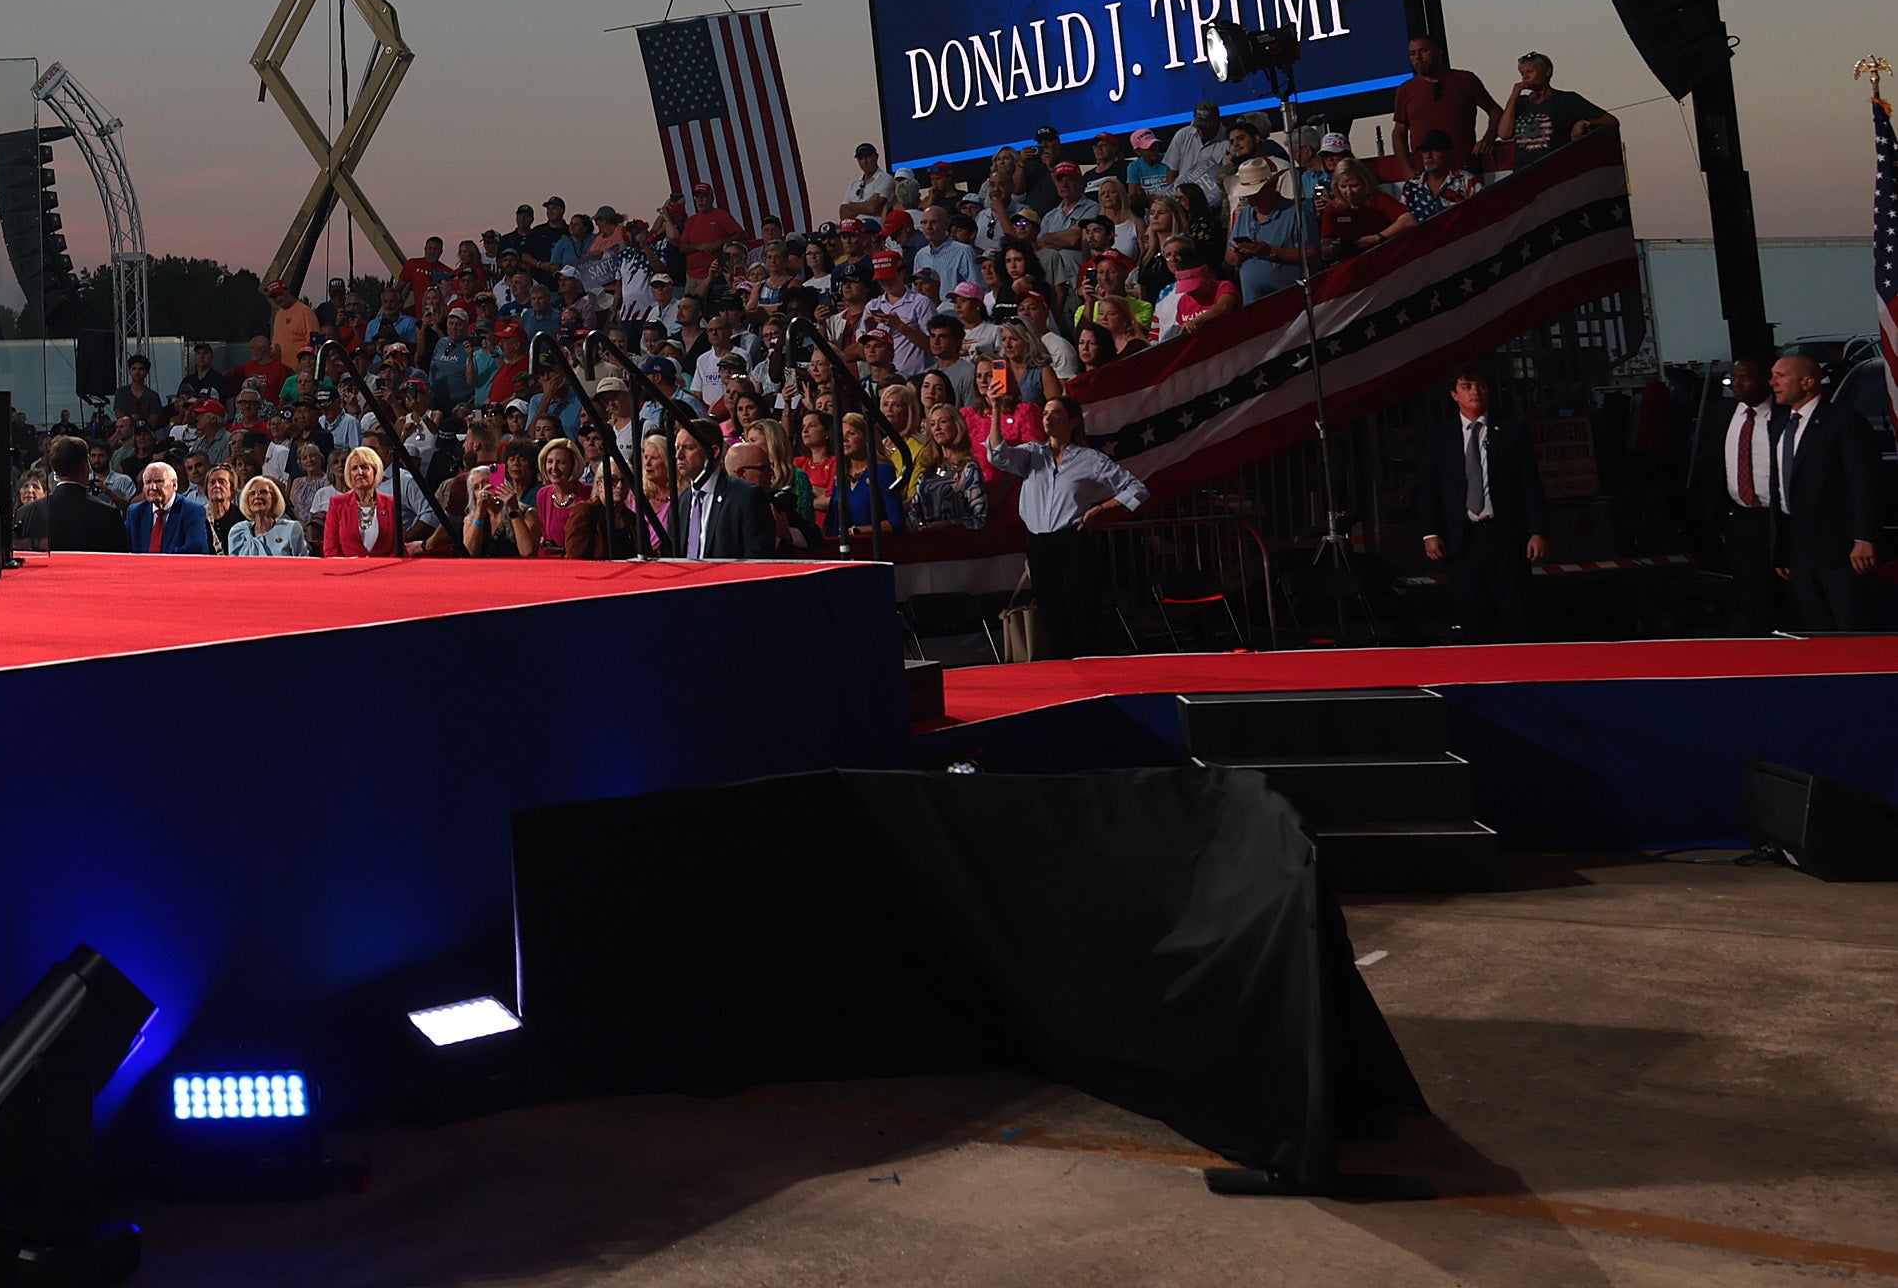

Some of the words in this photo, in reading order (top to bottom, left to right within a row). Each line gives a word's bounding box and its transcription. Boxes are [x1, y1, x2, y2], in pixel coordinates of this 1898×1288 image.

[905, 13, 1095, 120] DONALD
[1104, 2, 1142, 101] J.
[588, 259, 617, 280] SAFE
[1534, 421, 1590, 443] LEACHERS
